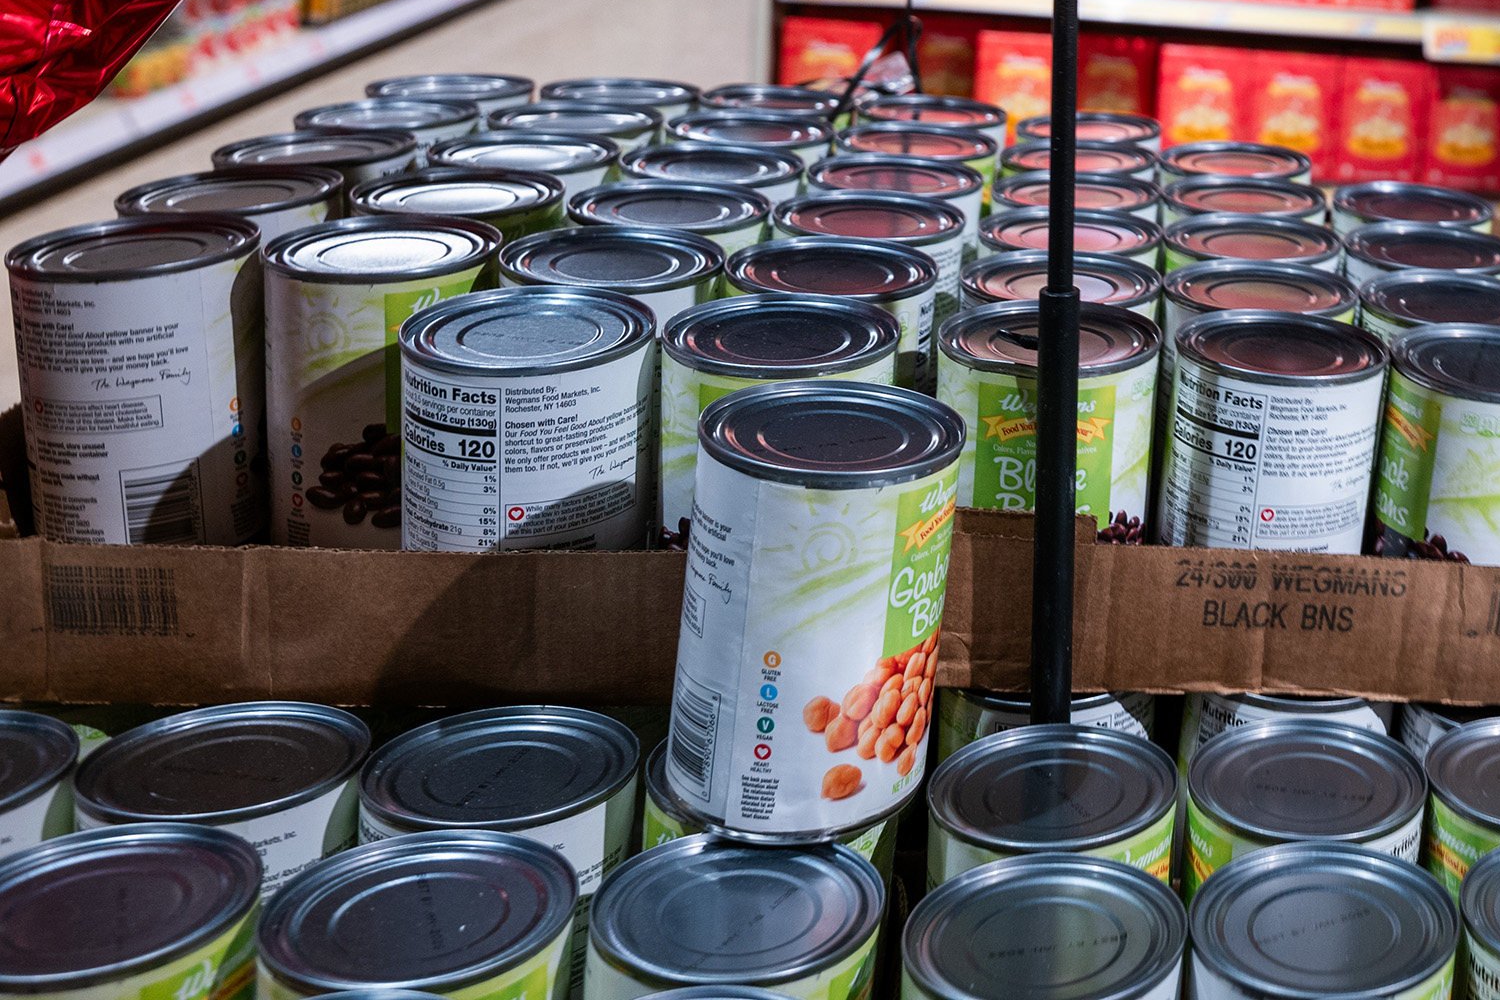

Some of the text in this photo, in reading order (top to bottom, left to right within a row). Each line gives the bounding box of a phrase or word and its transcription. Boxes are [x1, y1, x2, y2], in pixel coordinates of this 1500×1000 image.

[130, 327, 154, 336] banner
[164, 323, 179, 332] your
[405, 369, 496, 404] Nutrition Facts
[505, 395, 540, 405] Wegmans
[561, 387, 589, 399] Markets,
[591, 386, 600, 394] Inc.
[506, 386, 557, 396] Distributed By:
[506, 405, 542, 413] Rochester,
[556, 400, 576, 409] 14603
[1225, 391, 1263, 409] Facts
[460, 406, 496, 417] container
[450, 417, 465, 426] cup
[468, 419, 496, 429] (130g)
[505, 414, 578, 429] Chosen with Care!
[520, 429, 537, 437] Food
[540, 427, 552, 435] You
[554, 424, 569, 433] Feel
[570, 422, 587, 431] Good
[588, 417, 606, 428] About
[607, 411, 623, 422] yellow
[1002, 422, 1033, 436] Food You
[405, 423, 495, 458] Calories 120
[505, 438, 534, 447] shortcut
[545, 430, 588, 444] great-tasting
[589, 424, 614, 435] products
[616, 418, 625, 428] with
[1174, 421, 1213, 450] Calories
[1225, 439, 1257, 459] 120
[521, 455, 532, 464] only
[533, 453, 550, 462] offer
[551, 450, 579, 461] products
[591, 444, 603, 452] love
[609, 438, 618, 447] and
[620, 435, 626, 443] we
[531, 445, 554, 453] flavors
[565, 434, 607, 450] preservatives.
[451, 462, 469, 471] Daily
[547, 462, 560, 471] not,
[562, 459, 577, 468] we'll
[579, 456, 592, 465] give
[594, 453, 604, 461] you
[606, 449, 616, 458] your
[450, 525, 462, 535] 21g
[920, 521, 935, 540] Food
[1176, 559, 1407, 598] 24/300 WEGMANS
[1203, 600, 1354, 632] BLACK BNS
[761, 668, 781, 676] GLUTEN
[757, 701, 779, 709] LACTOSE
